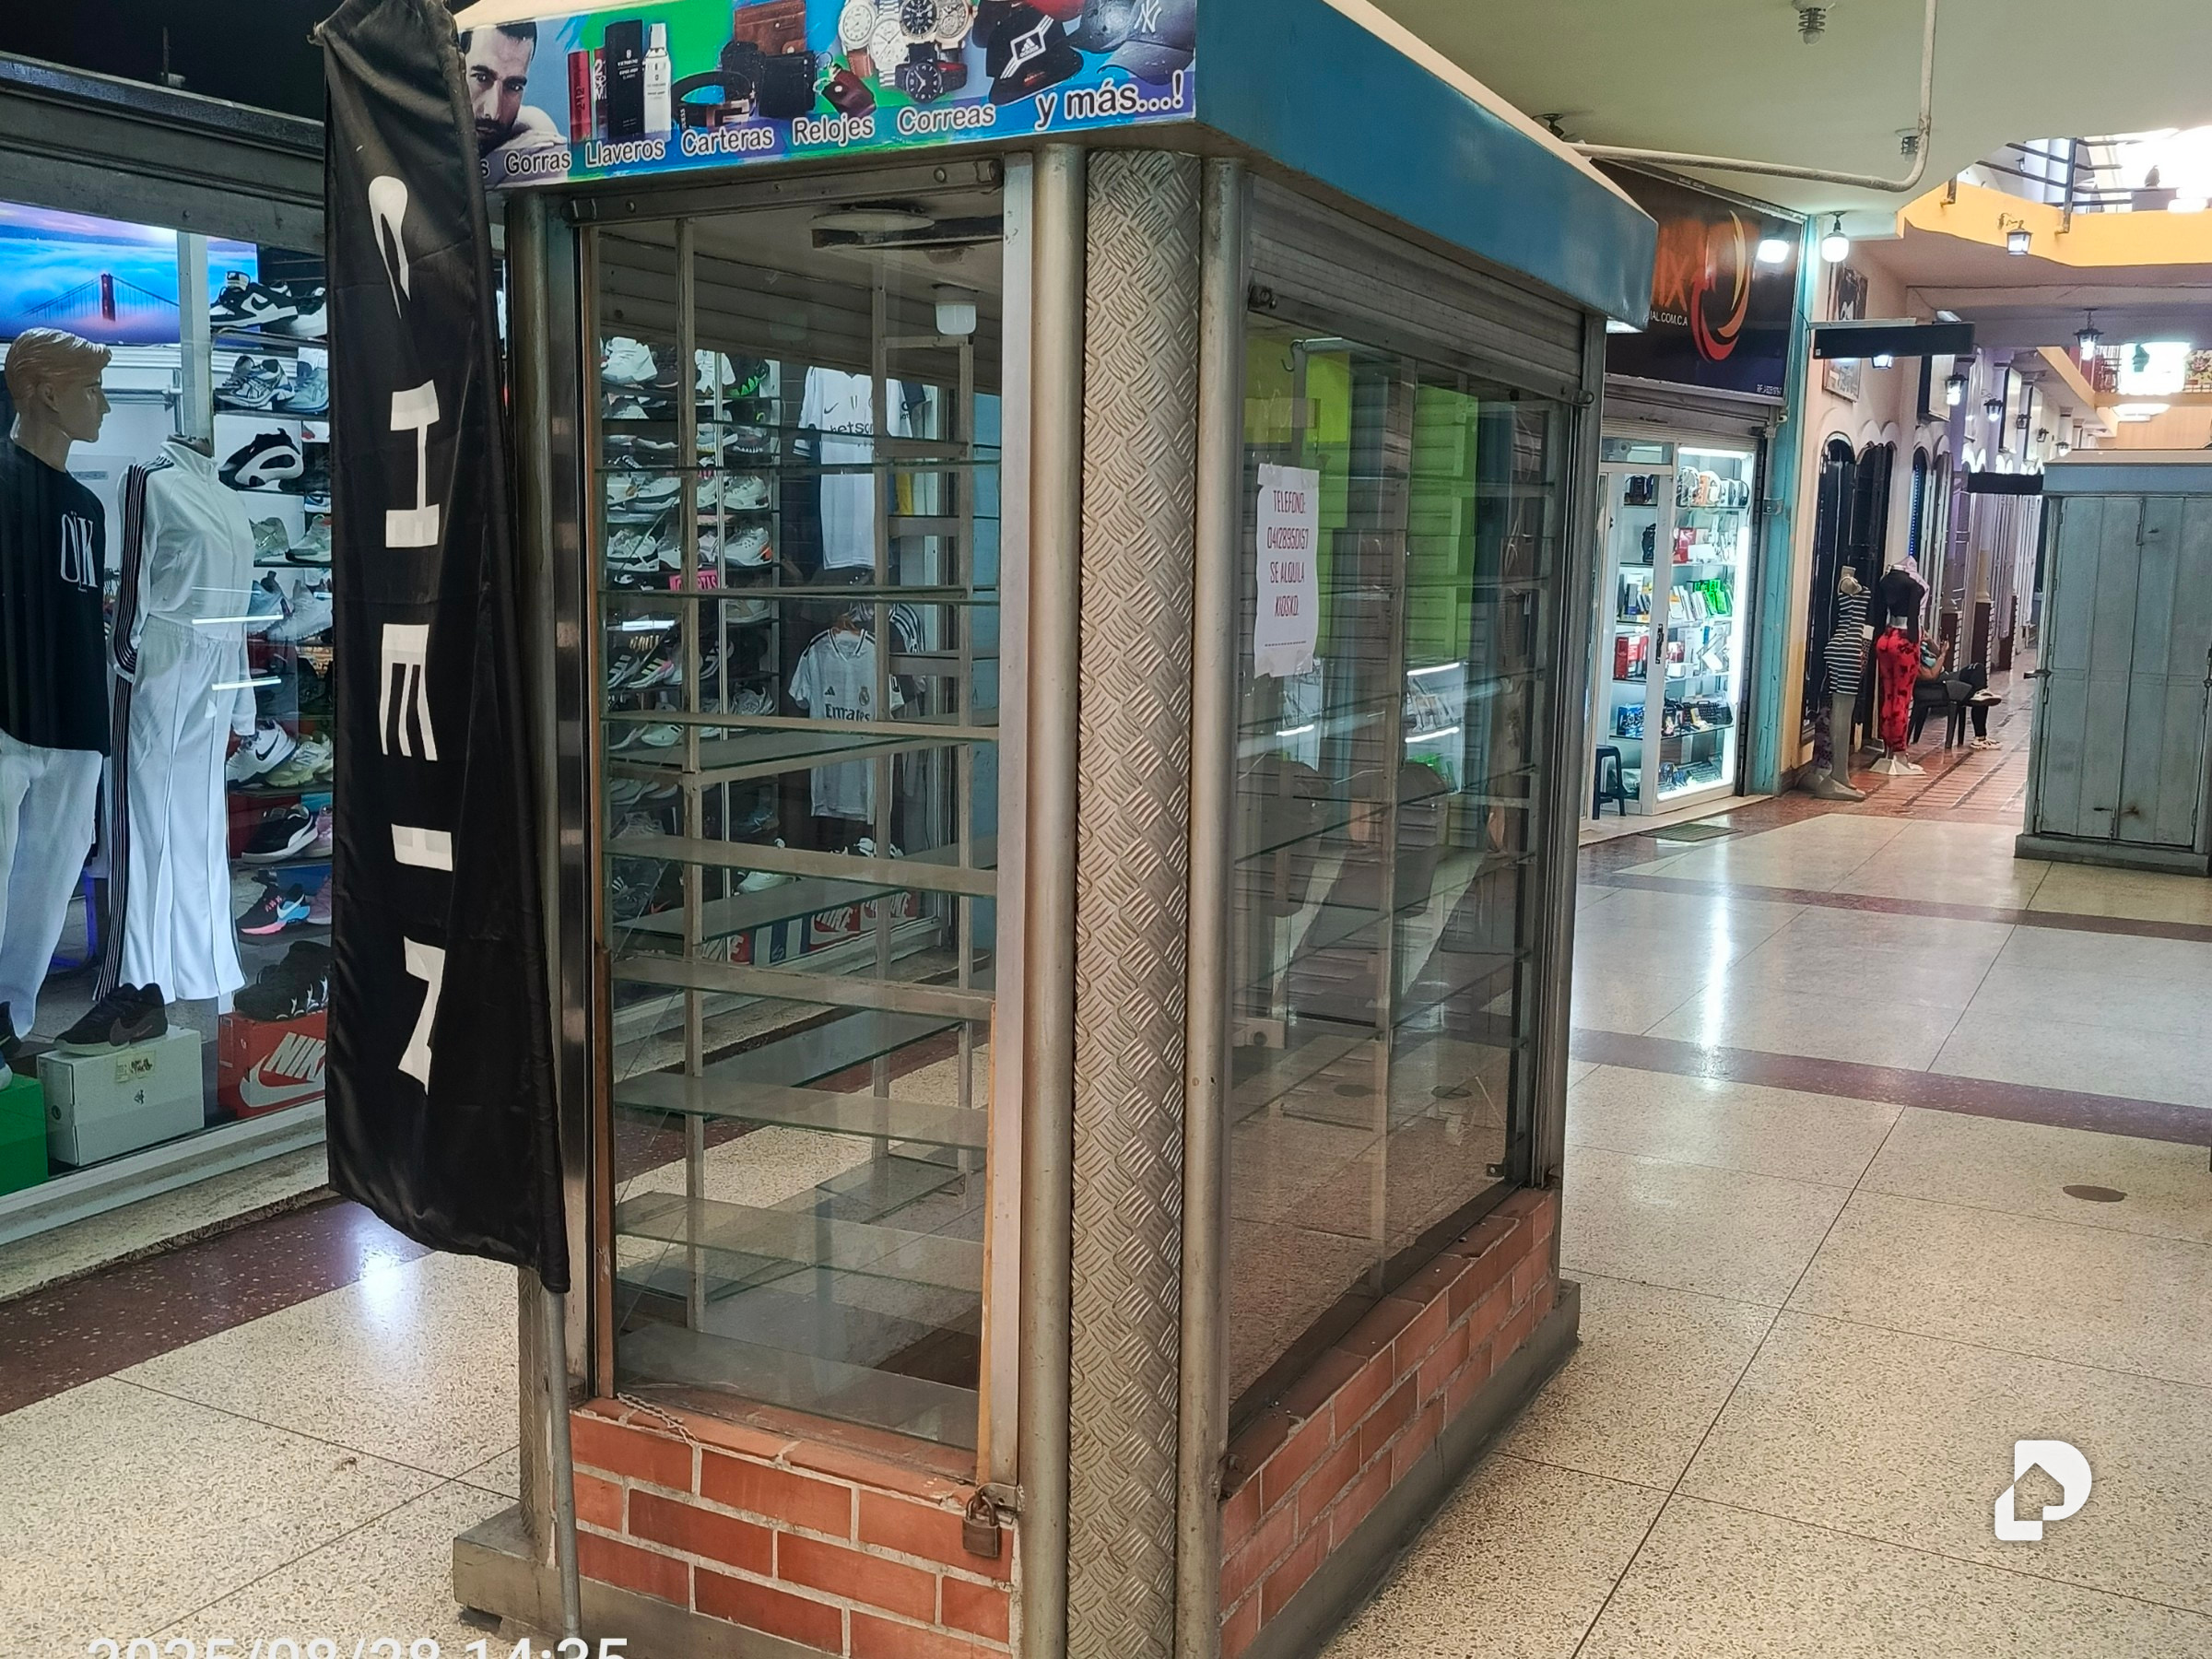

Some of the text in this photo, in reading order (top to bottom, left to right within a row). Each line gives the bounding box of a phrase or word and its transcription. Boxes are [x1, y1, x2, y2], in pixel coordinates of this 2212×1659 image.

[505, 150, 571, 175] Gorras
[585, 140, 665, 168] Llaveros
[680, 127, 774, 155] Carteras
[793, 116, 875, 146] Relojes
[897, 104, 995, 135] Correas
[1036, 93, 1057, 131] y
[1065, 70, 1184, 118] más...!
[1273, 489, 1305, 514] TELEFONO:
[1270, 561, 1305, 583] SE ALQUILA
[264, 1031, 326, 1080] NIK
